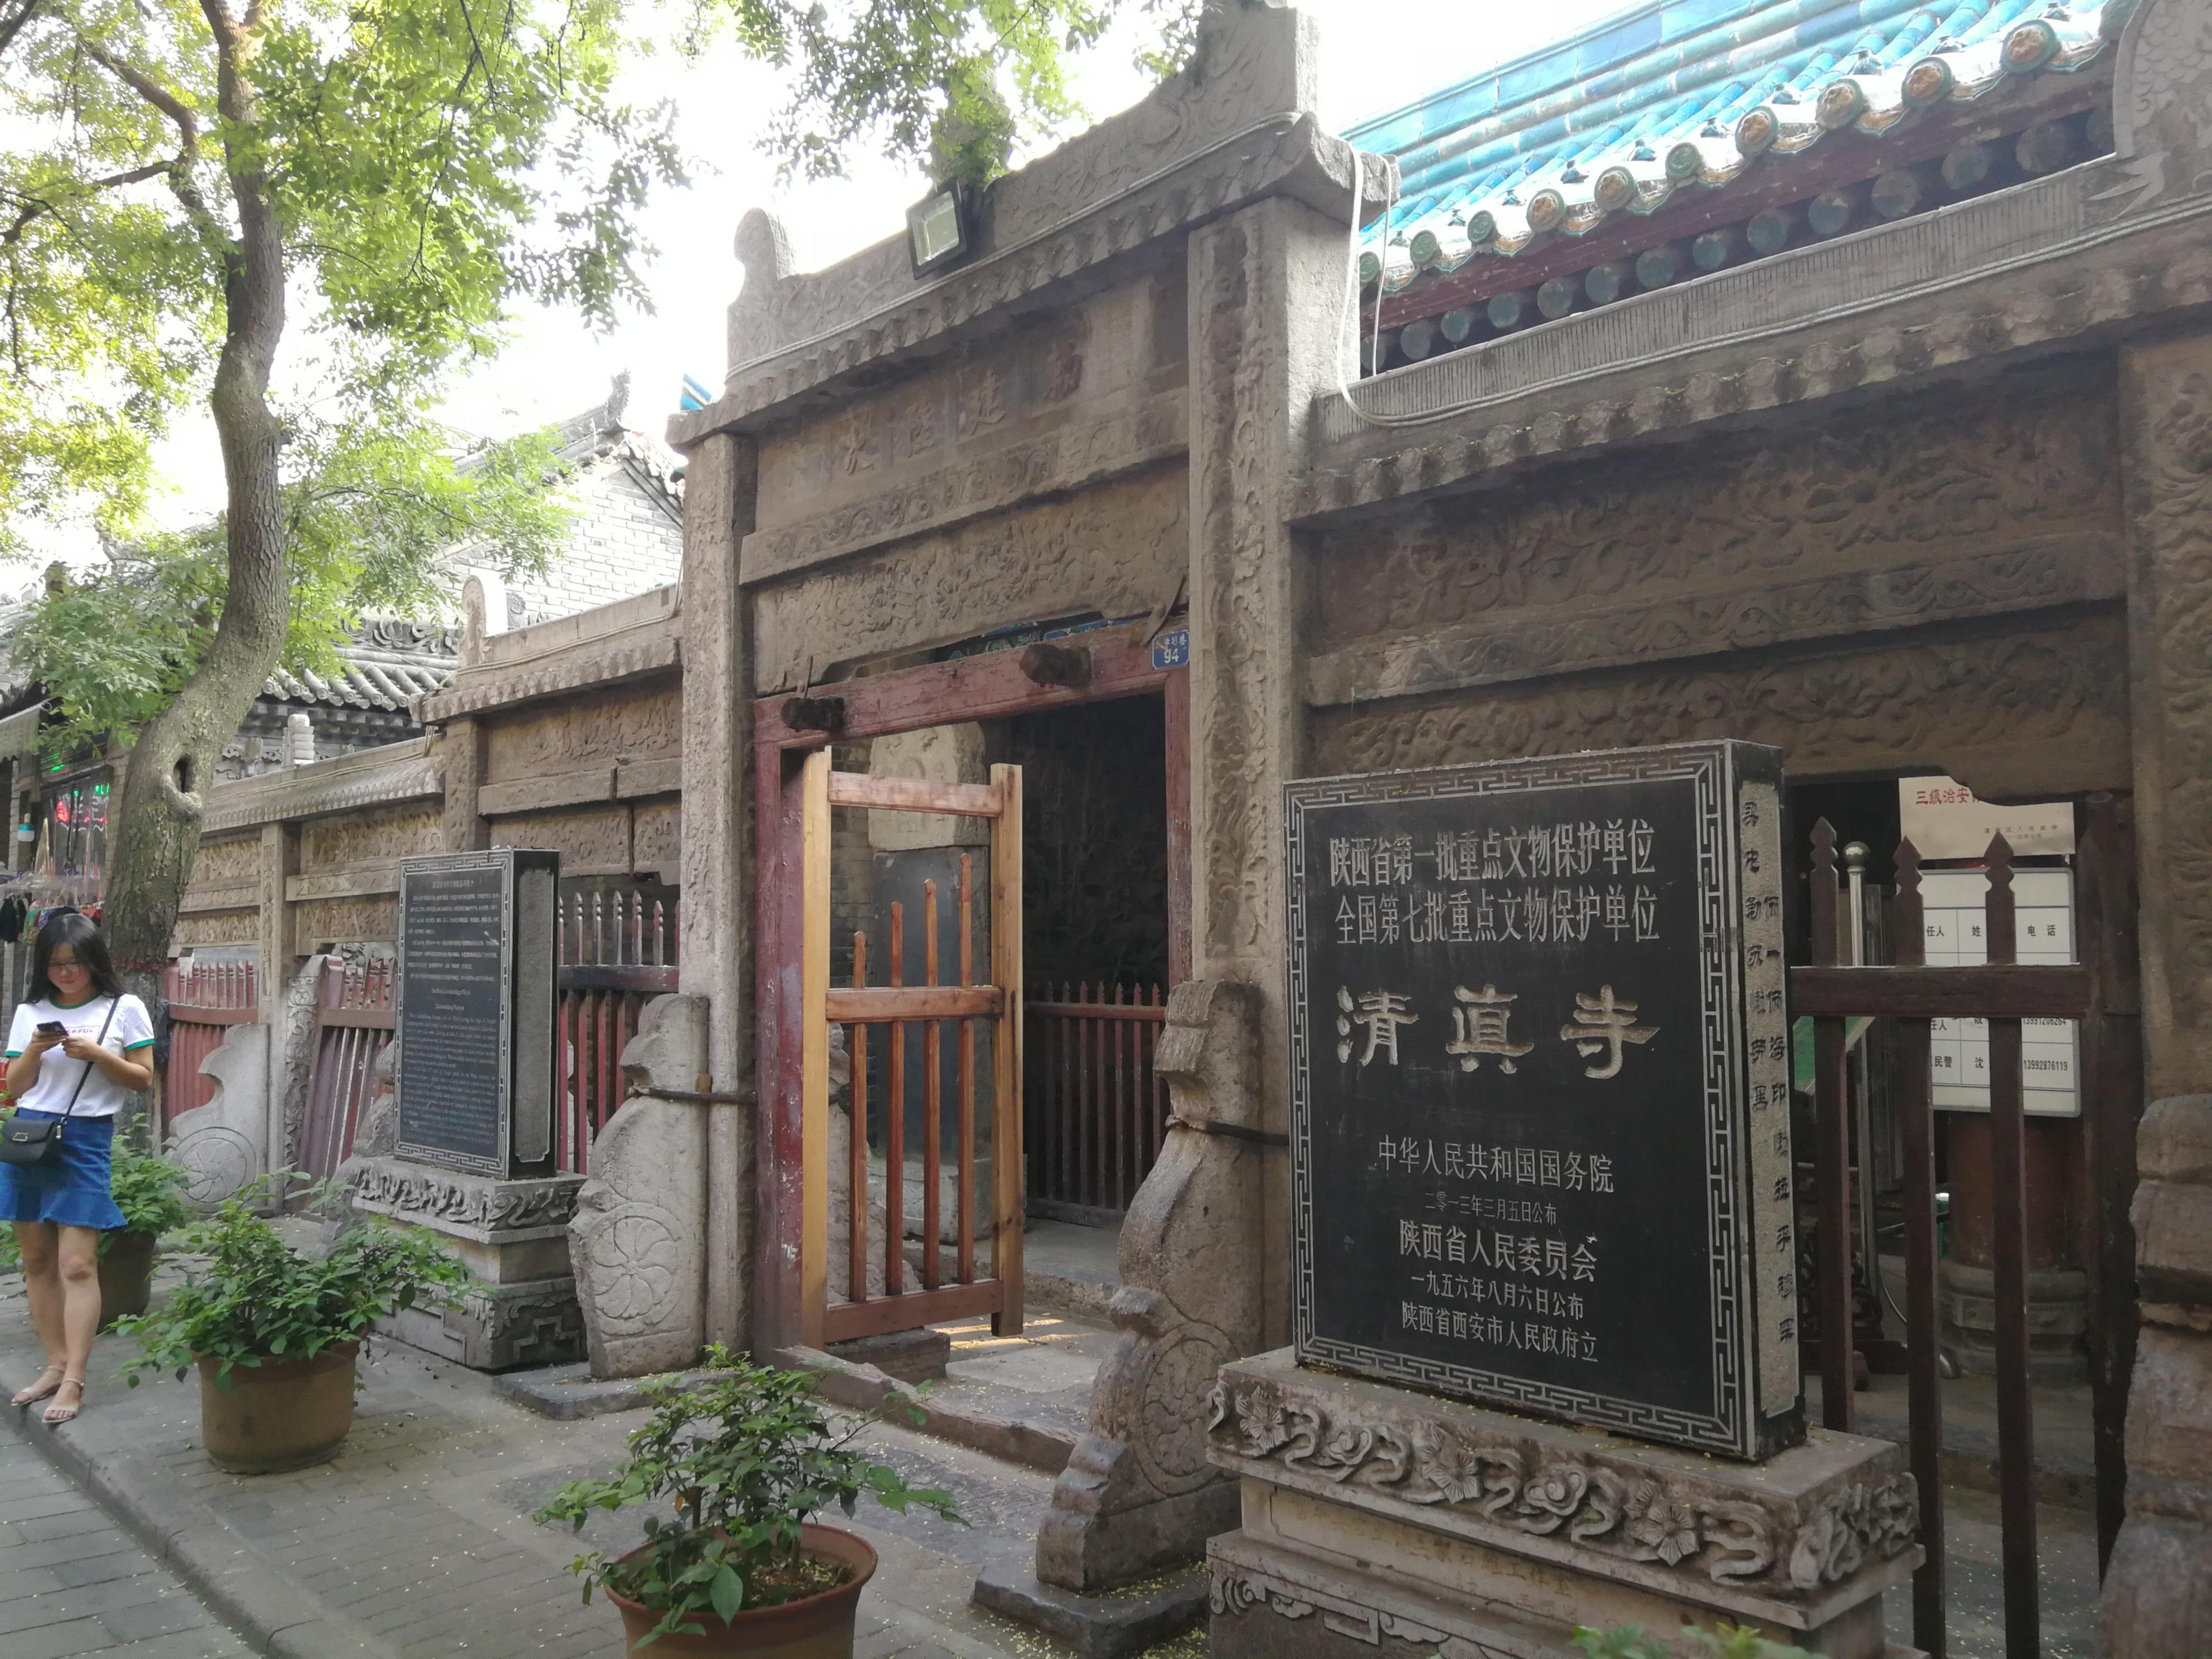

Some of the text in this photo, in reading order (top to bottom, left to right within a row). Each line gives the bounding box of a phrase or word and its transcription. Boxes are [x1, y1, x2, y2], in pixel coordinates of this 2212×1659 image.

[1164, 648, 1179, 663] 94
[1916, 787, 1980, 804] 三级治安
[1330, 818, 1656, 886] 陕西省第一批重点文物保护单位
[1335, 884, 1660, 944] 全国第七批重点文物保护单位
[1972, 925, 1981, 937] 姓
[1337, 984, 1661, 1079] 清真寺
[1930, 1056, 1953, 1068] 民警
[2024, 1060, 2068, 1071] 13992876119
[1379, 1134, 1614, 1193] 中华人民共和国国务院
[1425, 1191, 1557, 1226] 二零一三年三月五日公布
[1399, 1219, 1598, 1282] 陕西省人民委员会
[1411, 1269, 1584, 1321] 一九五六年八月六日公布
[1401, 1301, 1599, 1363] 陕西省西安市人民政府立
